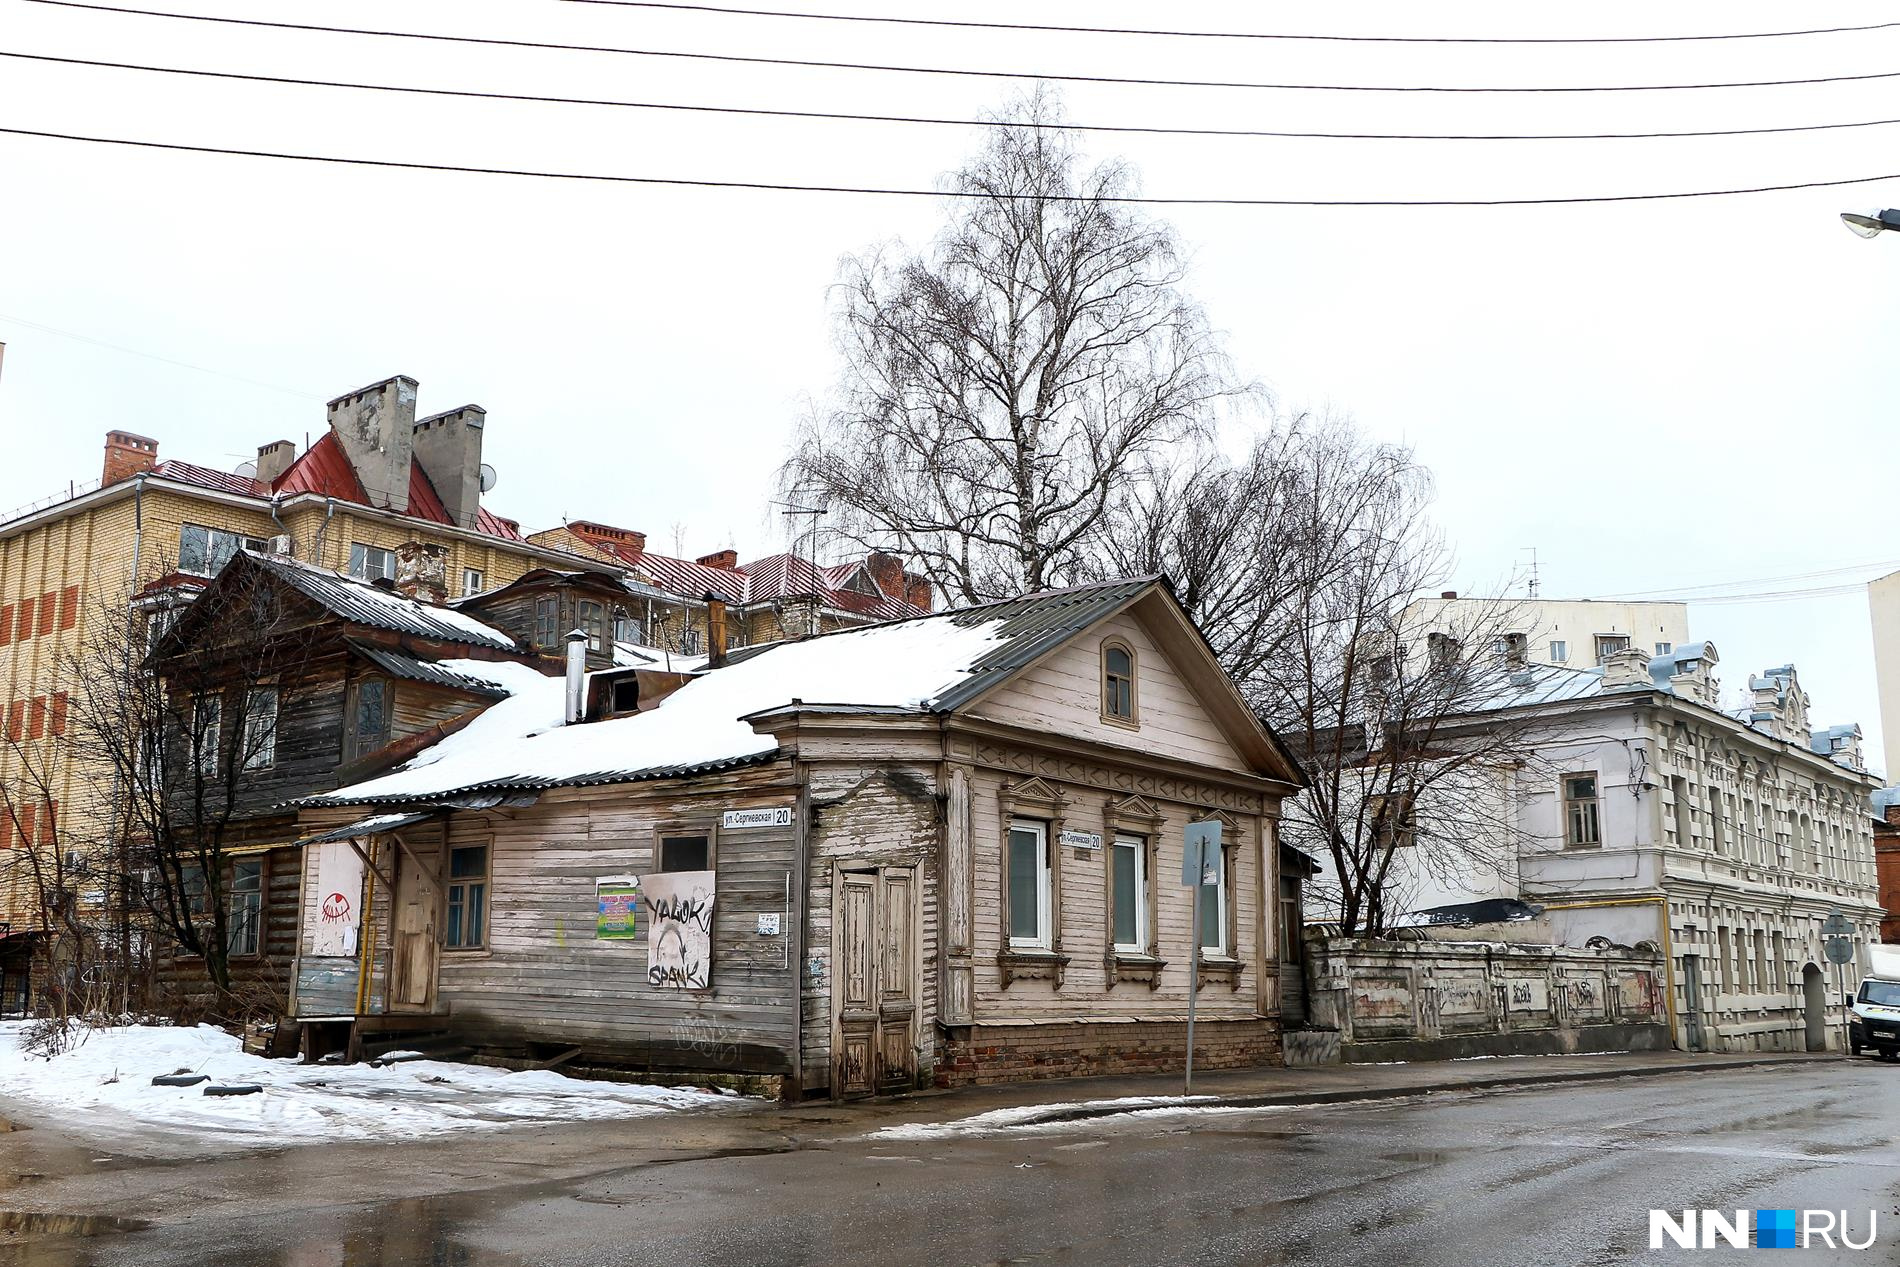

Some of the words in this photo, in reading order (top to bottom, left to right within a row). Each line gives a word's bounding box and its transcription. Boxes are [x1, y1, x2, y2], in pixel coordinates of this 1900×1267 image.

[735, 812, 772, 825] Сергиевская
[776, 810, 788, 824] 20
[1092, 836, 1100, 848] 20
